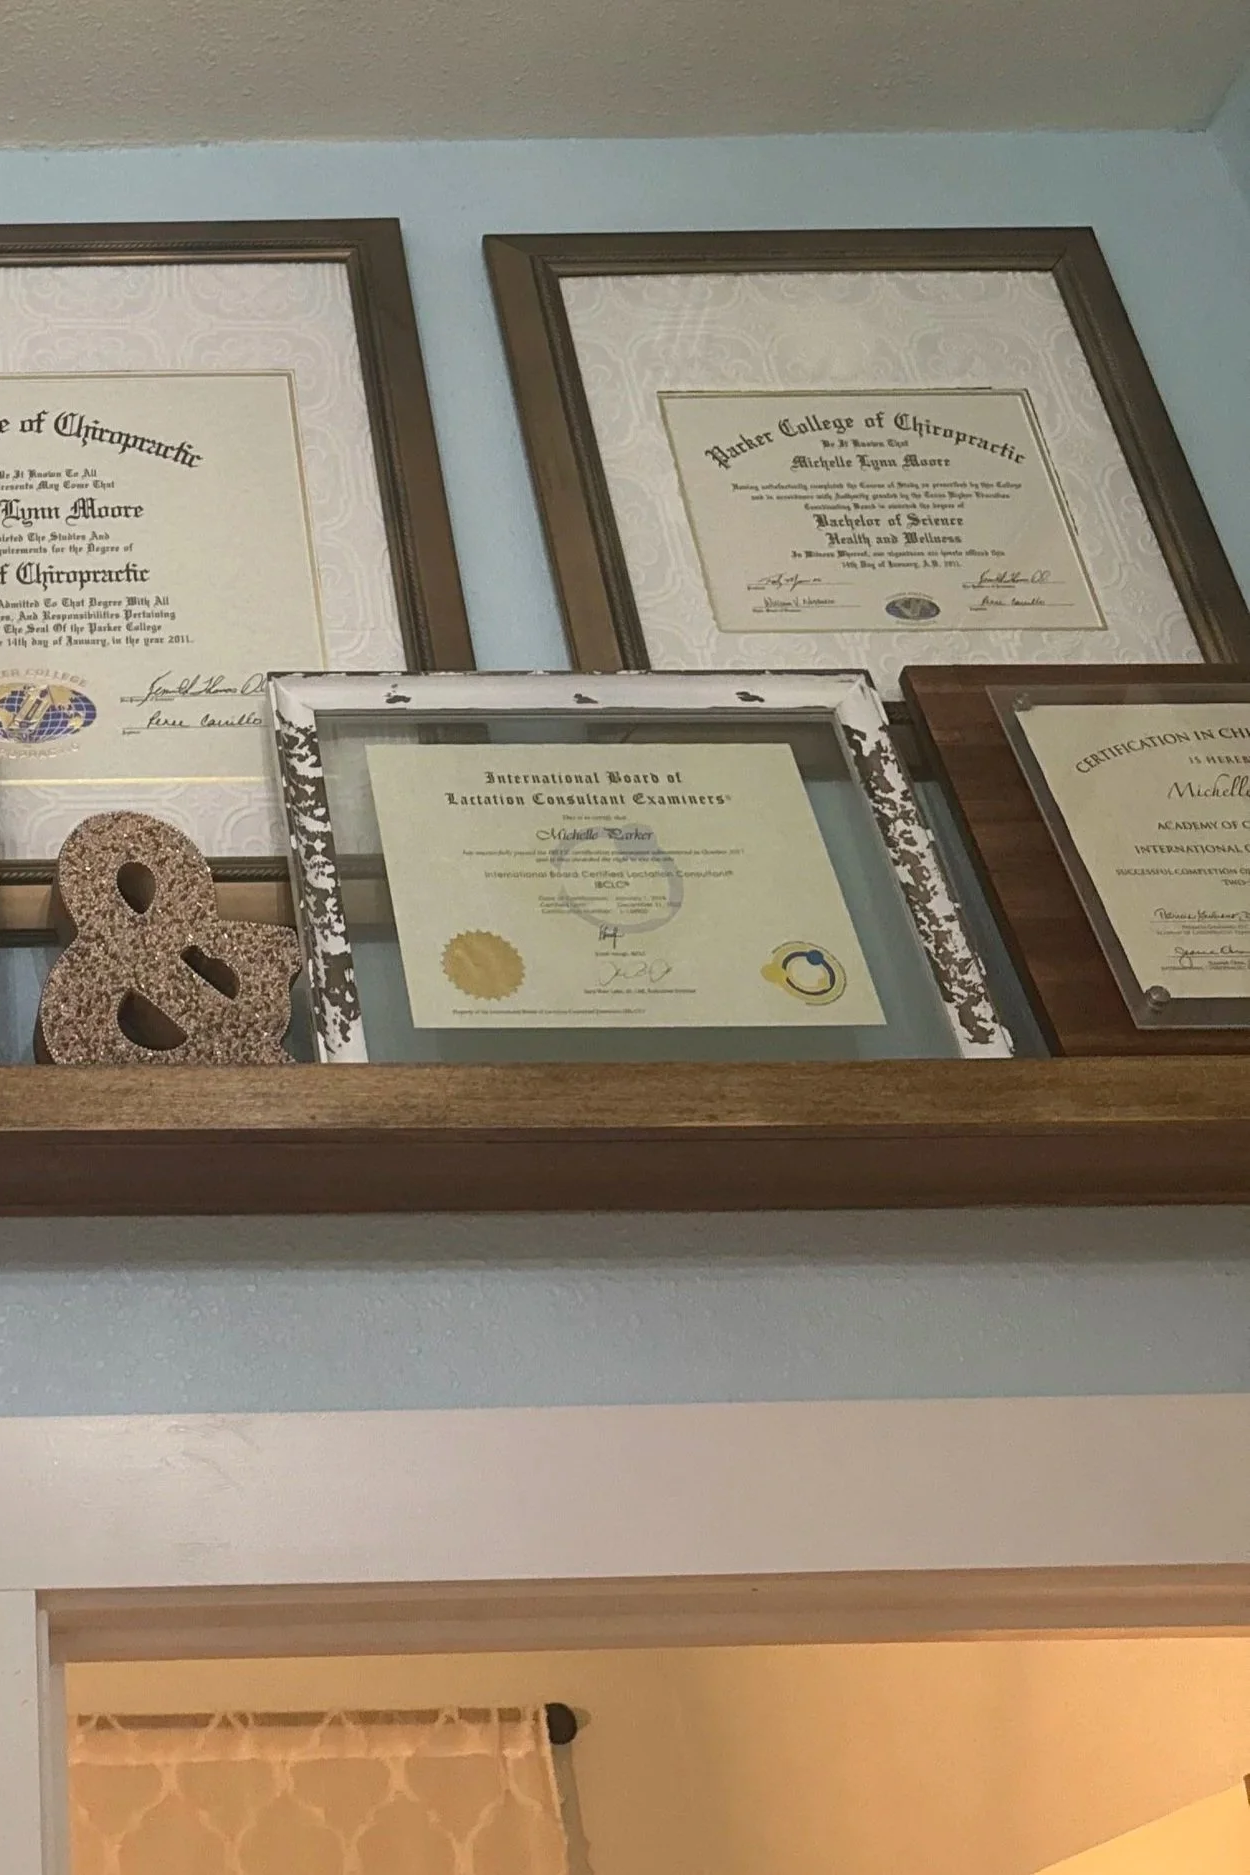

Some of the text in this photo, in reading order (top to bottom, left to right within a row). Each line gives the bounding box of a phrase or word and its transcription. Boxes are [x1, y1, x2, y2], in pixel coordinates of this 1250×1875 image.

[20, 410, 49, 433] of
[53, 411, 203, 468] Chiropractic
[705, 412, 1026, 470] Parker College of Chiropractic
[790, 454, 950, 472] Michelle Lynn Moore
[13, 469, 24, 479] It
[28, 469, 61, 479] Known
[65, 469, 79, 478] To
[82, 468, 96, 478] All
[37, 481, 59, 491] May
[63, 480, 89, 489] Come
[93, 480, 115, 490] That
[0, 499, 60, 528] Lynn
[65, 498, 144, 526] Moore
[813, 513, 964, 529] Bachelor of Science
[27, 533, 46, 543] The
[49, 532, 86, 543] Studies
[89, 532, 110, 541] And
[825, 532, 962, 547] Health and Wellness
[51, 544, 64, 553] for
[69, 543, 83, 554] the
[87, 543, 119, 555] Degree
[124, 543, 134, 552] of
[16, 562, 150, 591] Chiropractic
[44, 599, 57, 607] To
[62, 598, 84, 609] That
[88, 598, 122, 608] Degree
[126, 597, 150, 606] With
[153, 596, 169, 606] All
[19, 611, 38, 620] And
[42, 611, 120, 621] Responsibilities
[123, 610, 176, 620] Pertaining
[4, 624, 22, 635] The
[26, 624, 49, 633] Seal
[70, 622, 84, 634] the
[88, 623, 121, 634] Parker
[126, 622, 162, 632] College
[8, 637, 27, 648] 14th
[31, 637, 48, 648] day
[52, 636, 62, 645] of
[112, 636, 121, 644] in
[126, 637, 139, 647] the
[144, 637, 164, 647] year
[26, 668, 88, 687] COLLEGE
[1075, 727, 1250, 773] CERTIFICATION IN CHI
[1189, 756, 1201, 764] IS
[484, 771, 682, 785] International Board of
[444, 793, 525, 806] Lactation
[532, 793, 626, 806] Consultant
[1157, 821, 1238, 830] ACADEMY OF
[536, 828, 654, 841] Michelle Parker
[1135, 845, 1243, 854] INTERNATIONAL
[485, 871, 547, 879] International
[550, 871, 578, 879] Board
[581, 871, 623, 879] Certified
[626, 871, 673, 879] Lactation
